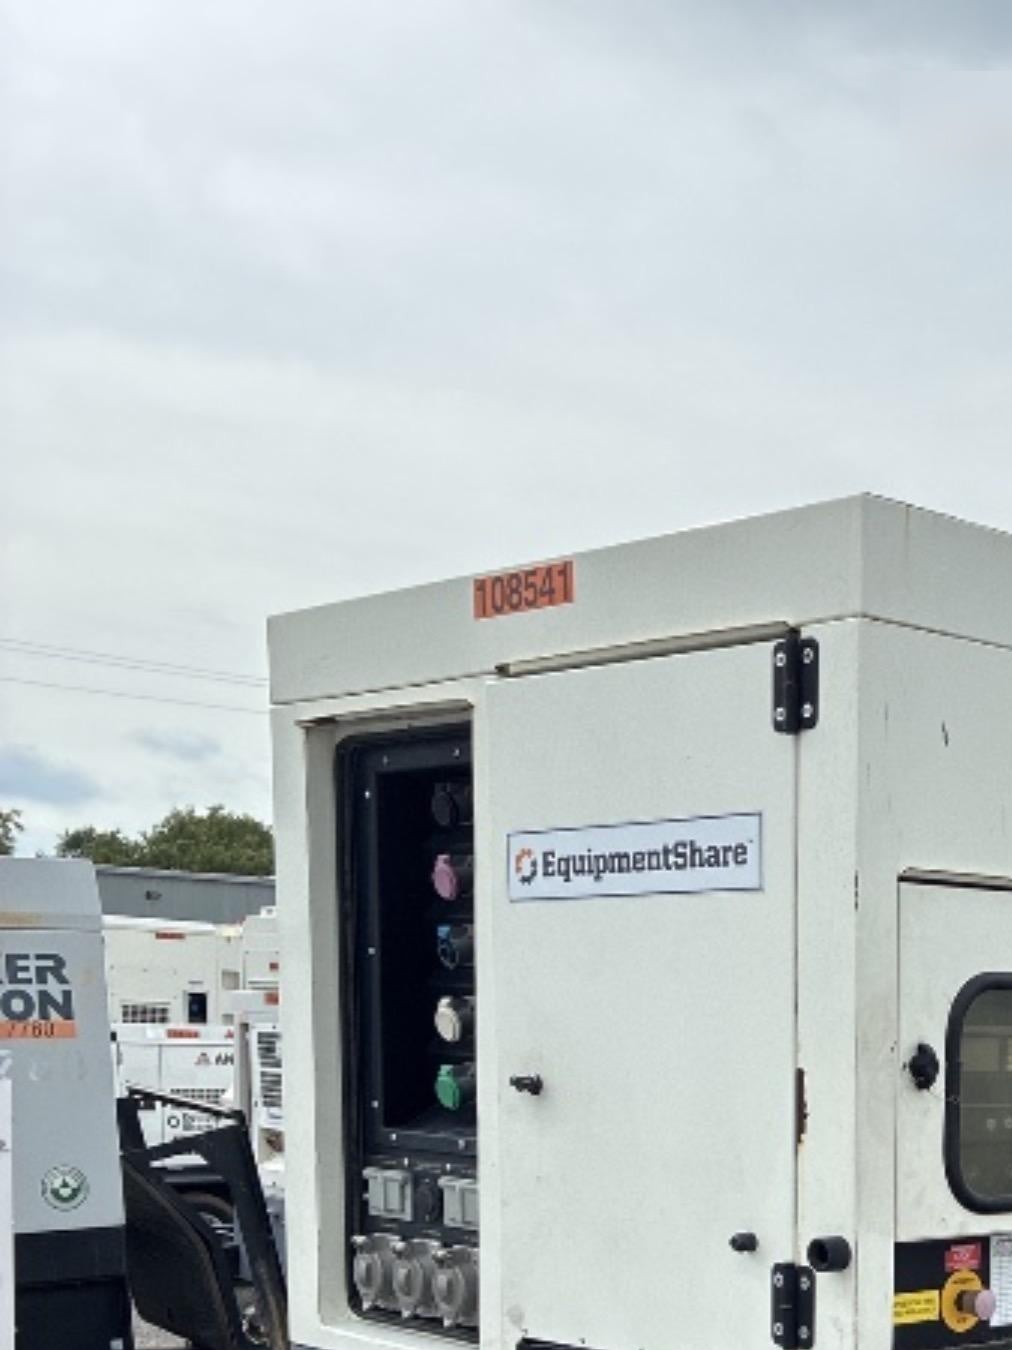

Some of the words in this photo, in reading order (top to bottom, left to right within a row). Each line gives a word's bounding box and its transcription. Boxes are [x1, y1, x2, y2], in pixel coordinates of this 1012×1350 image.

[475, 560, 573, 618] 108541
[542, 840, 748, 882] EquipmentShare
[0, 953, 70, 985] ER
